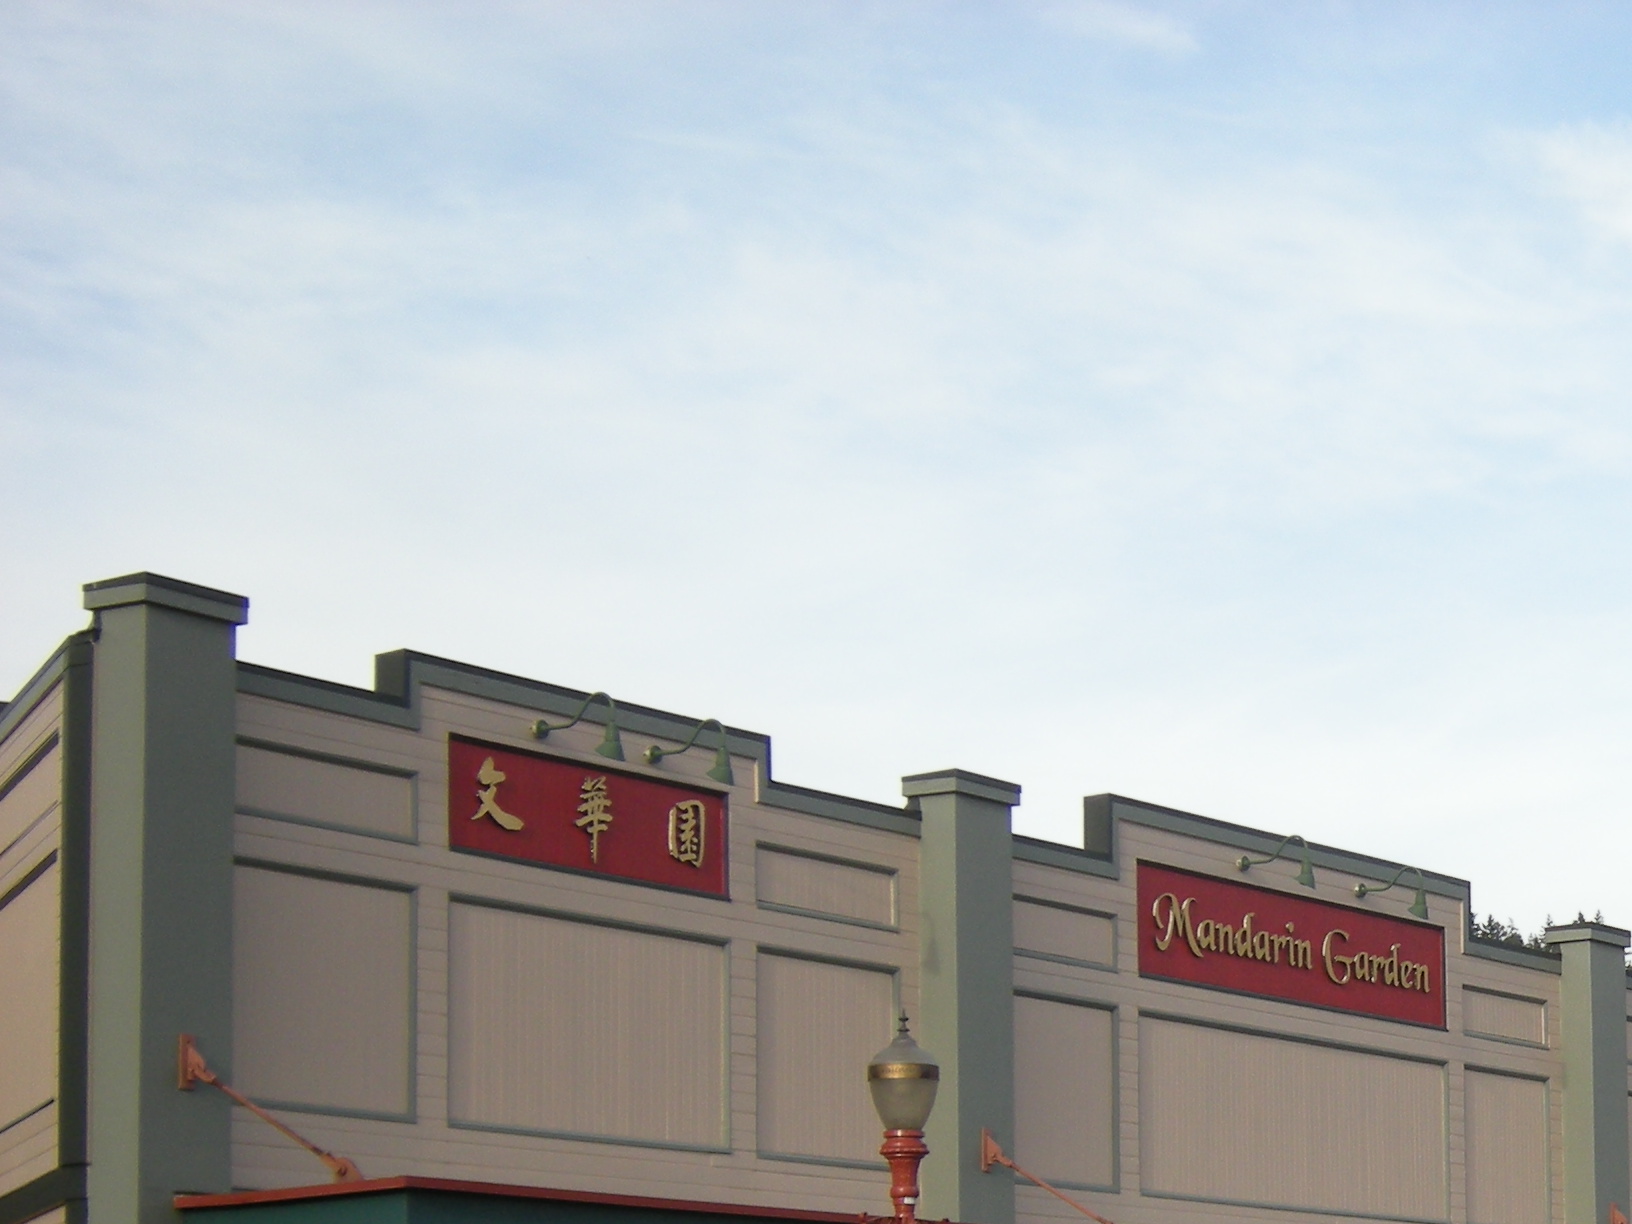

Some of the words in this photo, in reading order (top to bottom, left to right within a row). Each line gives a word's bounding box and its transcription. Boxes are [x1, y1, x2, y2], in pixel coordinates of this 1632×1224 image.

[471, 756, 706, 869] 文華園
[1152, 892, 1313, 971] Mandarin
[1322, 928, 1431, 994] Garden
